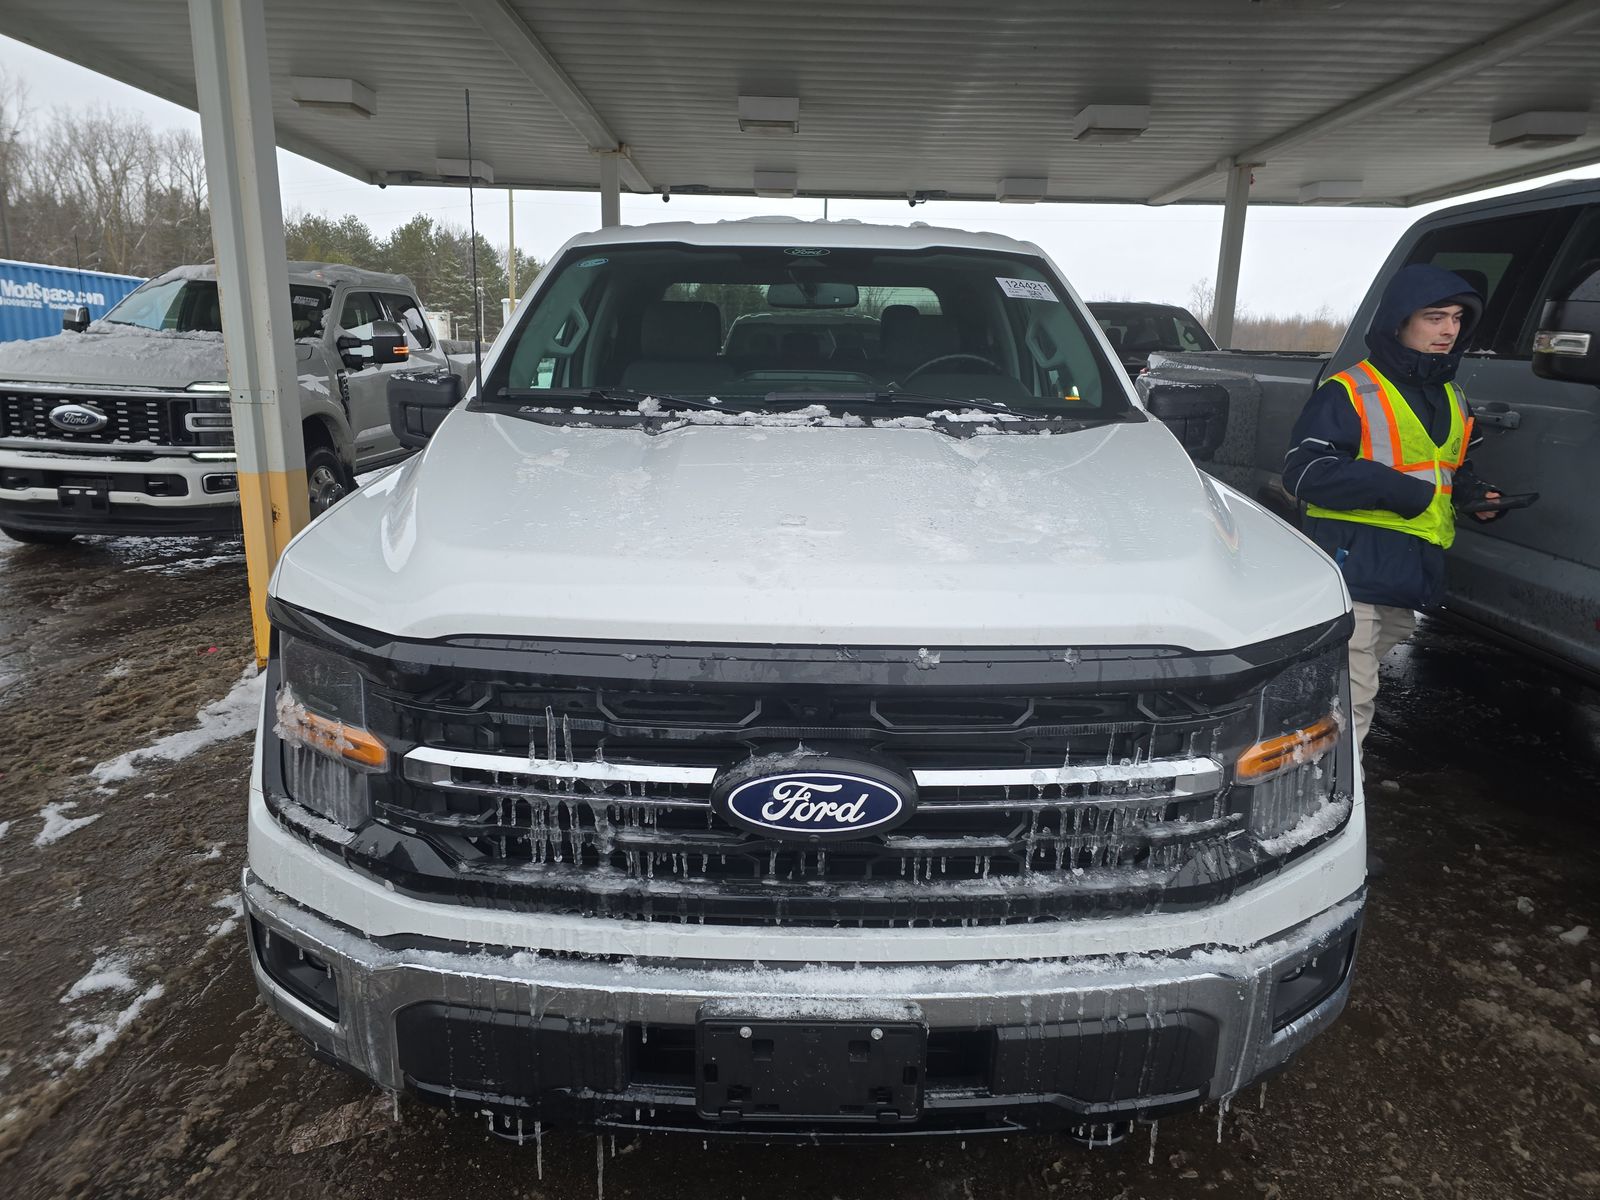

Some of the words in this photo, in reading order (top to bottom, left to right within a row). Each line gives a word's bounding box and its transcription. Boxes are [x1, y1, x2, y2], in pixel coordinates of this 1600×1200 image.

[0, 279, 105, 305] ModSpace.com
[1005, 280, 1051, 292] 1244211
[62, 411, 89, 425] Ford
[761, 781, 869, 823] Ford
